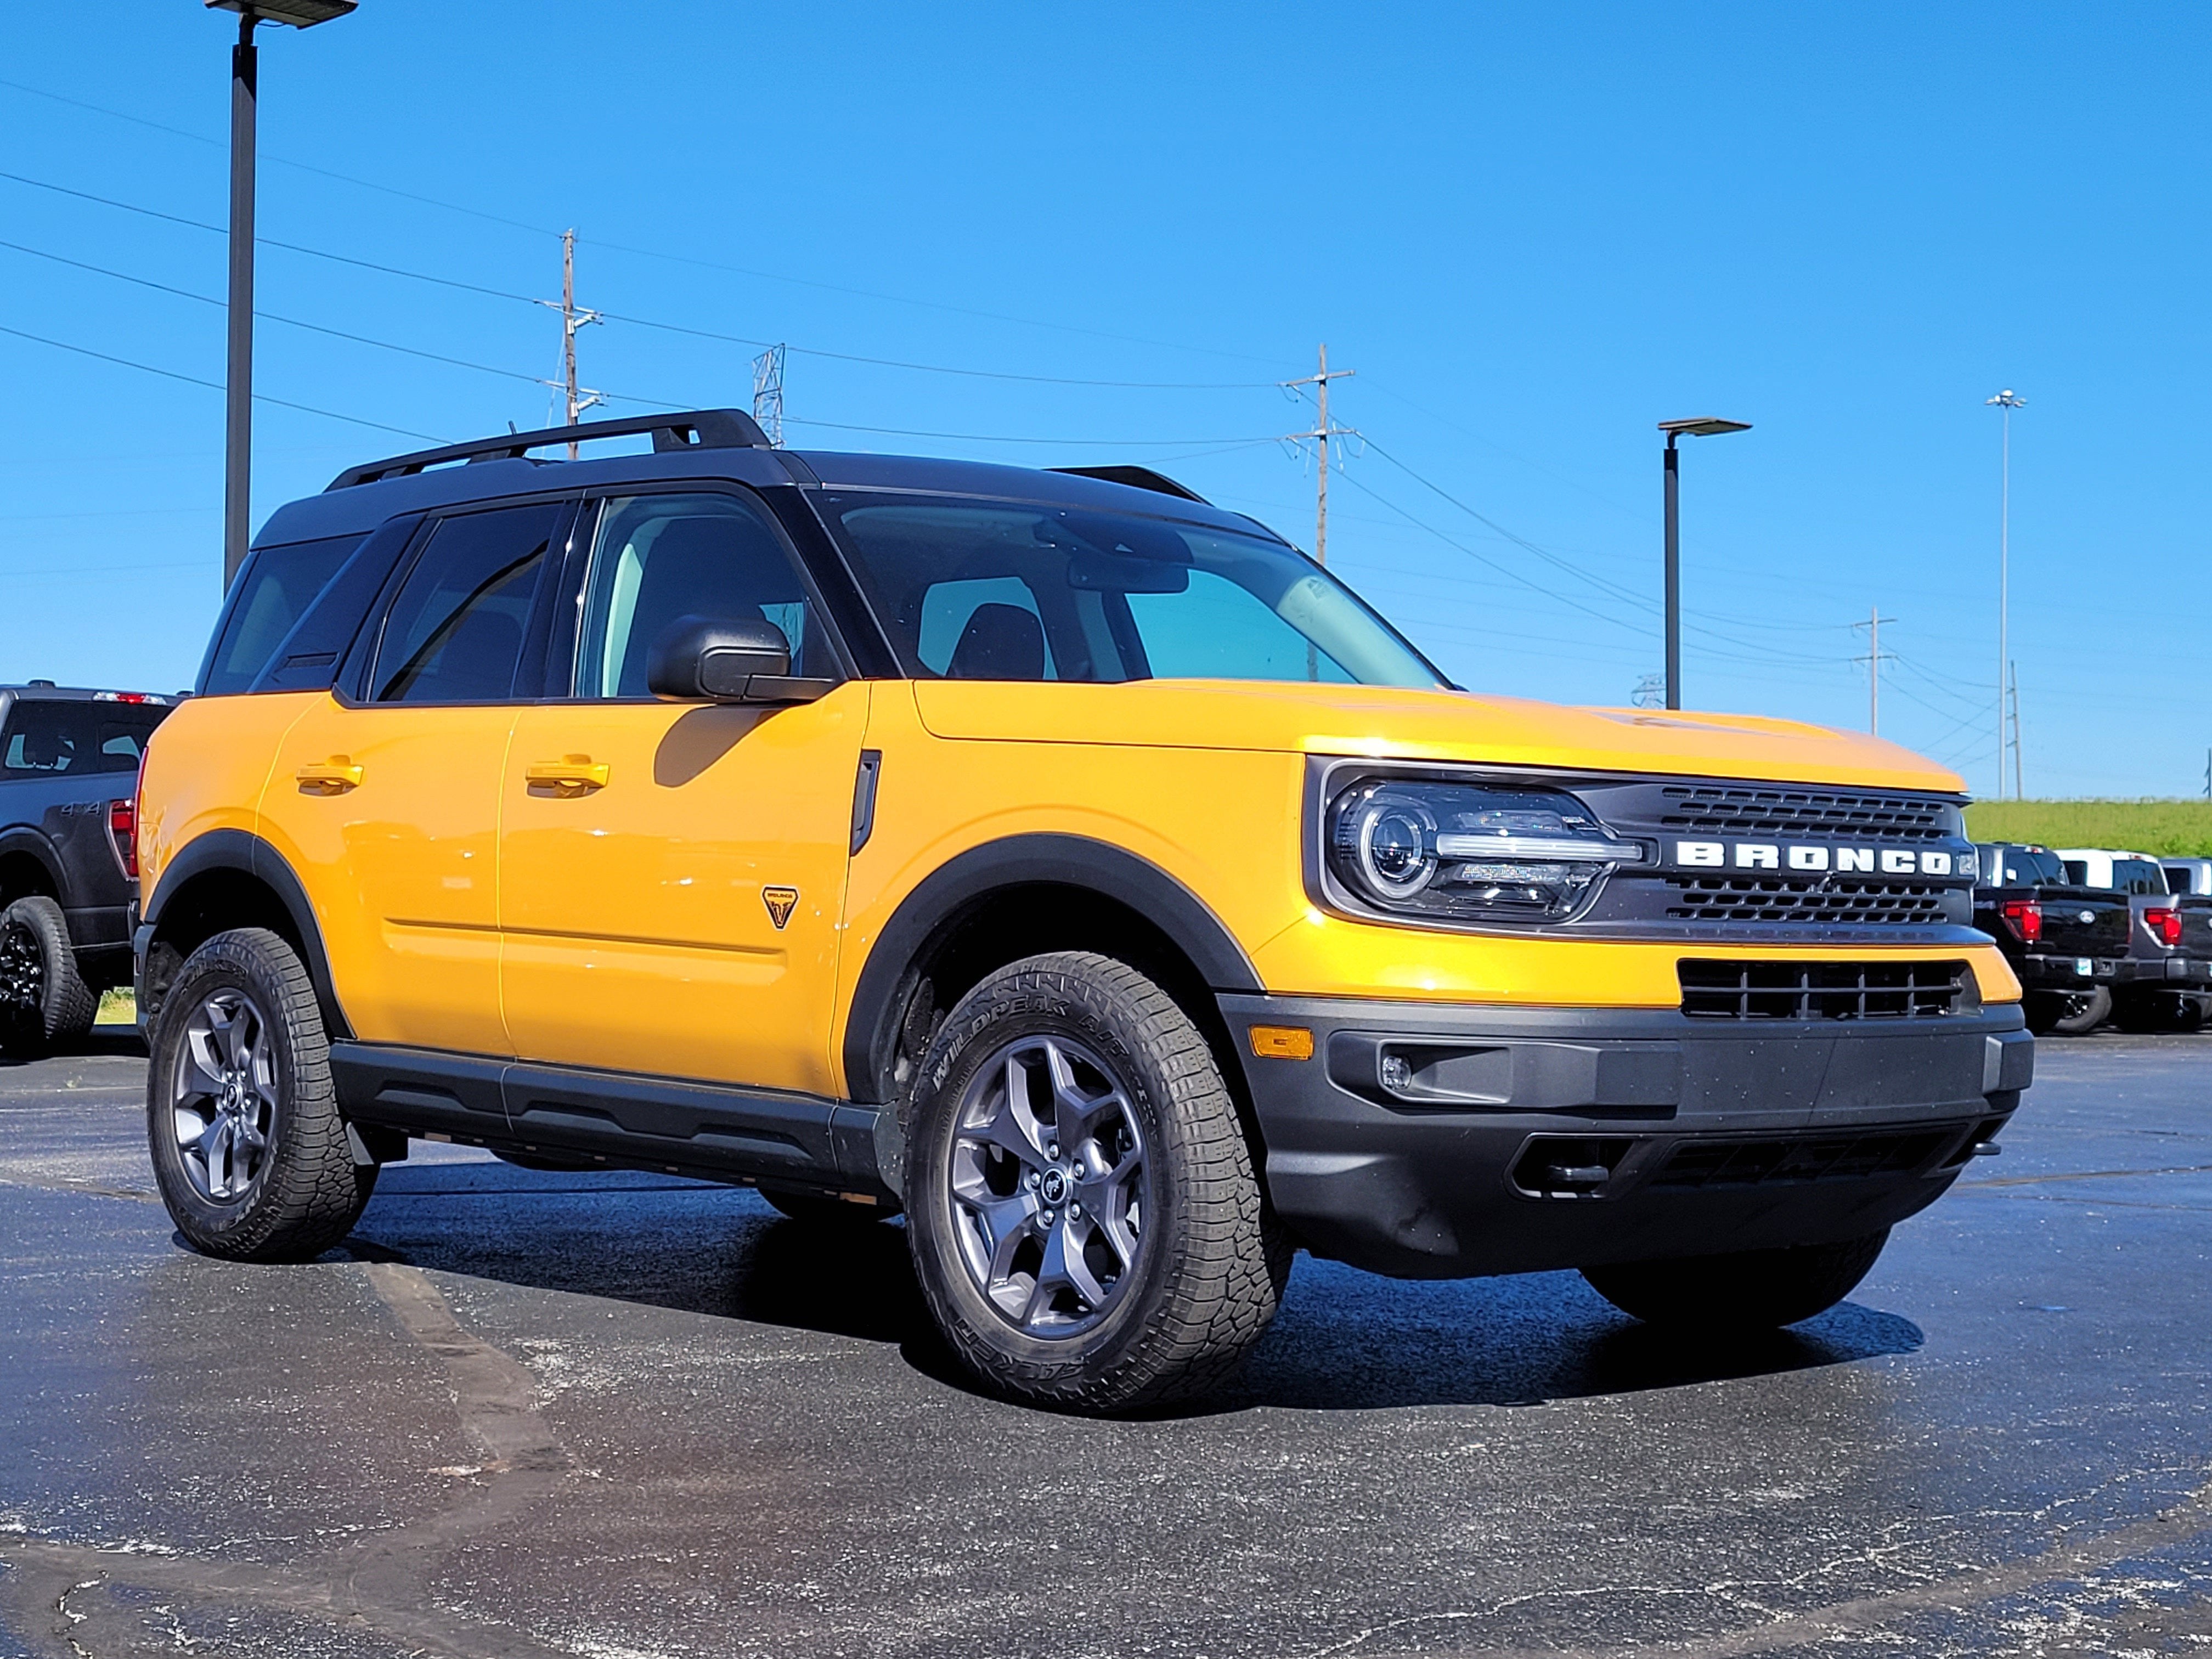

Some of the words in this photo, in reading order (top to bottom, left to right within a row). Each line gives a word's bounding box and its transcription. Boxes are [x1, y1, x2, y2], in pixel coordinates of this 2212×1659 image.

[1677, 841, 1951, 875] BRONCO
[932, 995, 1071, 1092] WILDPEAK
[953, 1317, 1087, 1383] FALKEN
